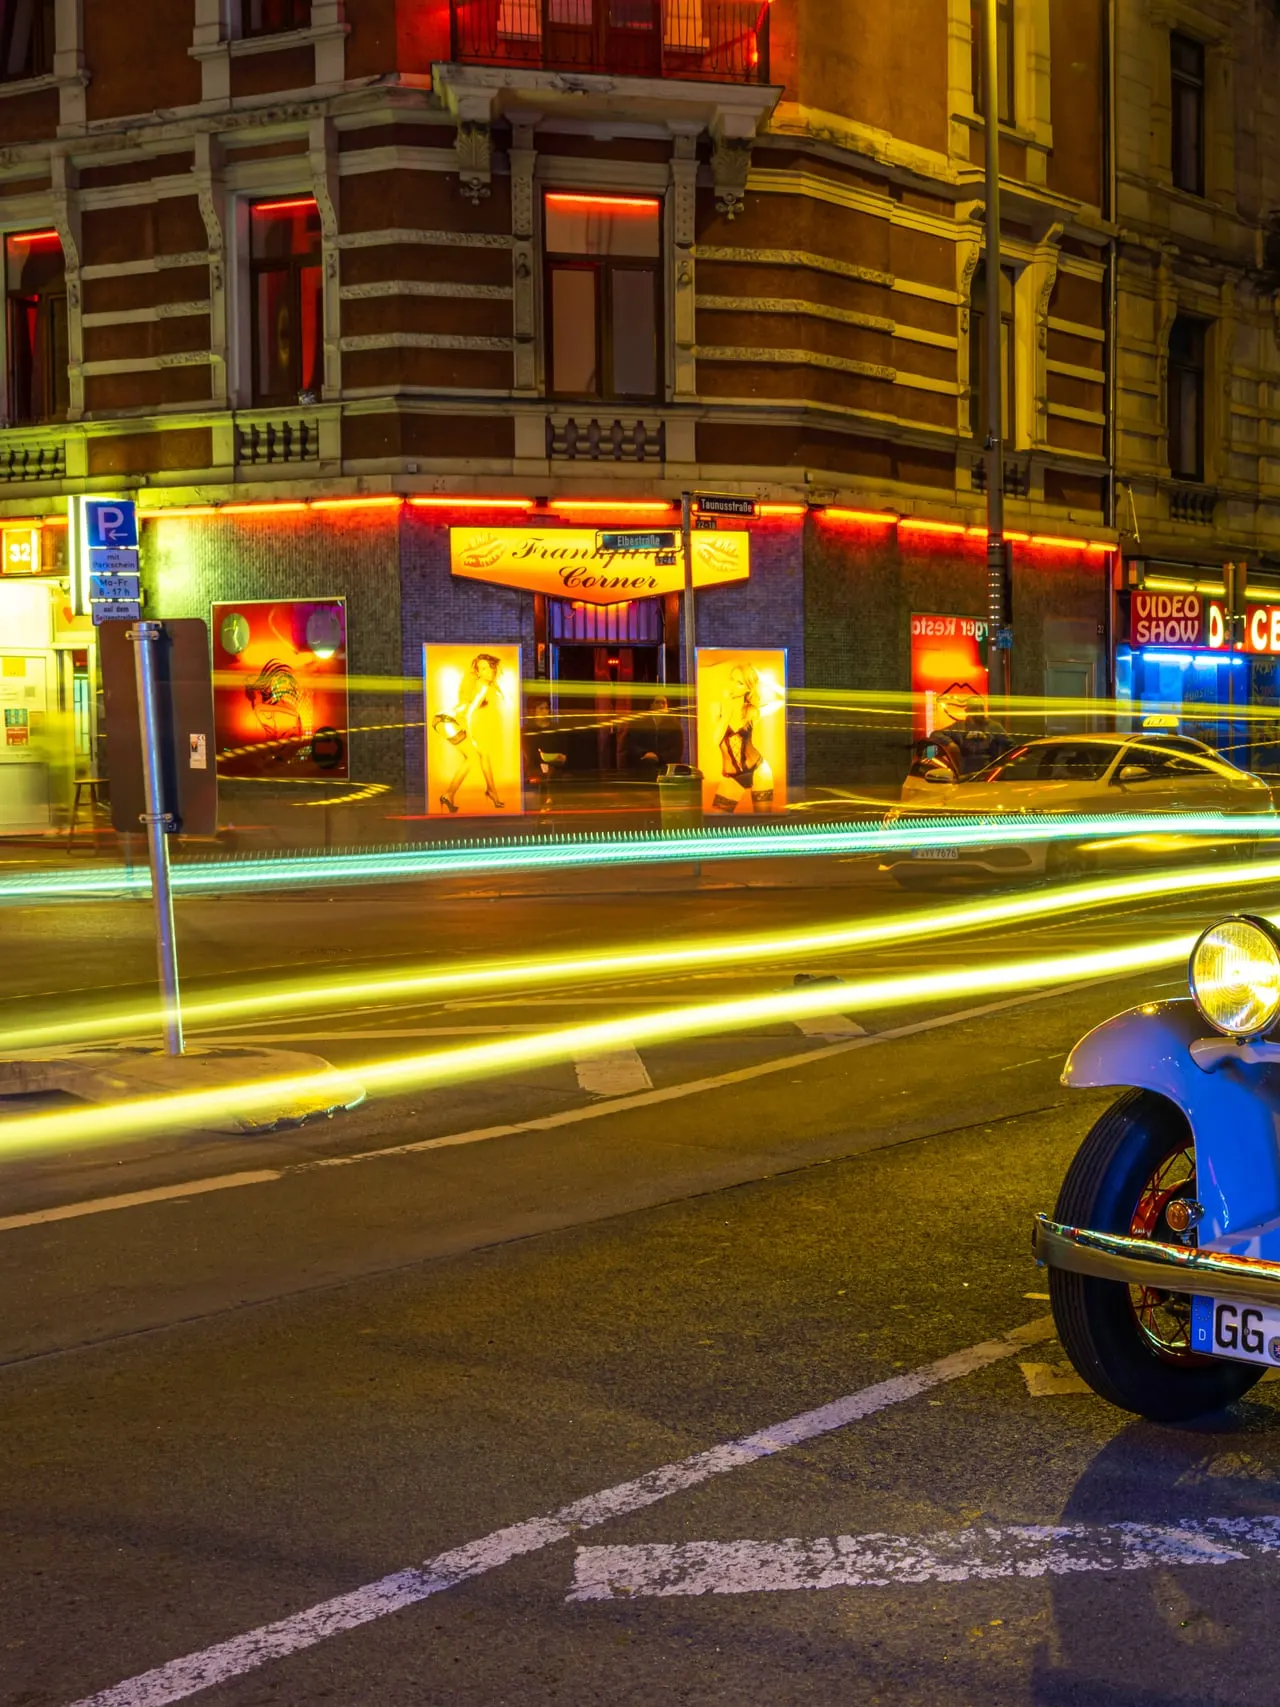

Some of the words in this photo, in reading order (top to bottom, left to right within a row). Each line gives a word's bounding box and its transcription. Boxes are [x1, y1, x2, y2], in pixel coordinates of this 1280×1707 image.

[702, 499, 752, 513] Taunusstraße
[617, 534, 660, 547] Elbestraße
[10, 543, 30, 562] 32
[559, 566, 658, 588] Corner
[113, 588, 122, 596] 17
[1136, 595, 1200, 618] VIDEO
[1136, 620, 1200, 643] SHOW
[1198, 1328, 1206, 1341] D
[1215, 1304, 1264, 1355] GG
